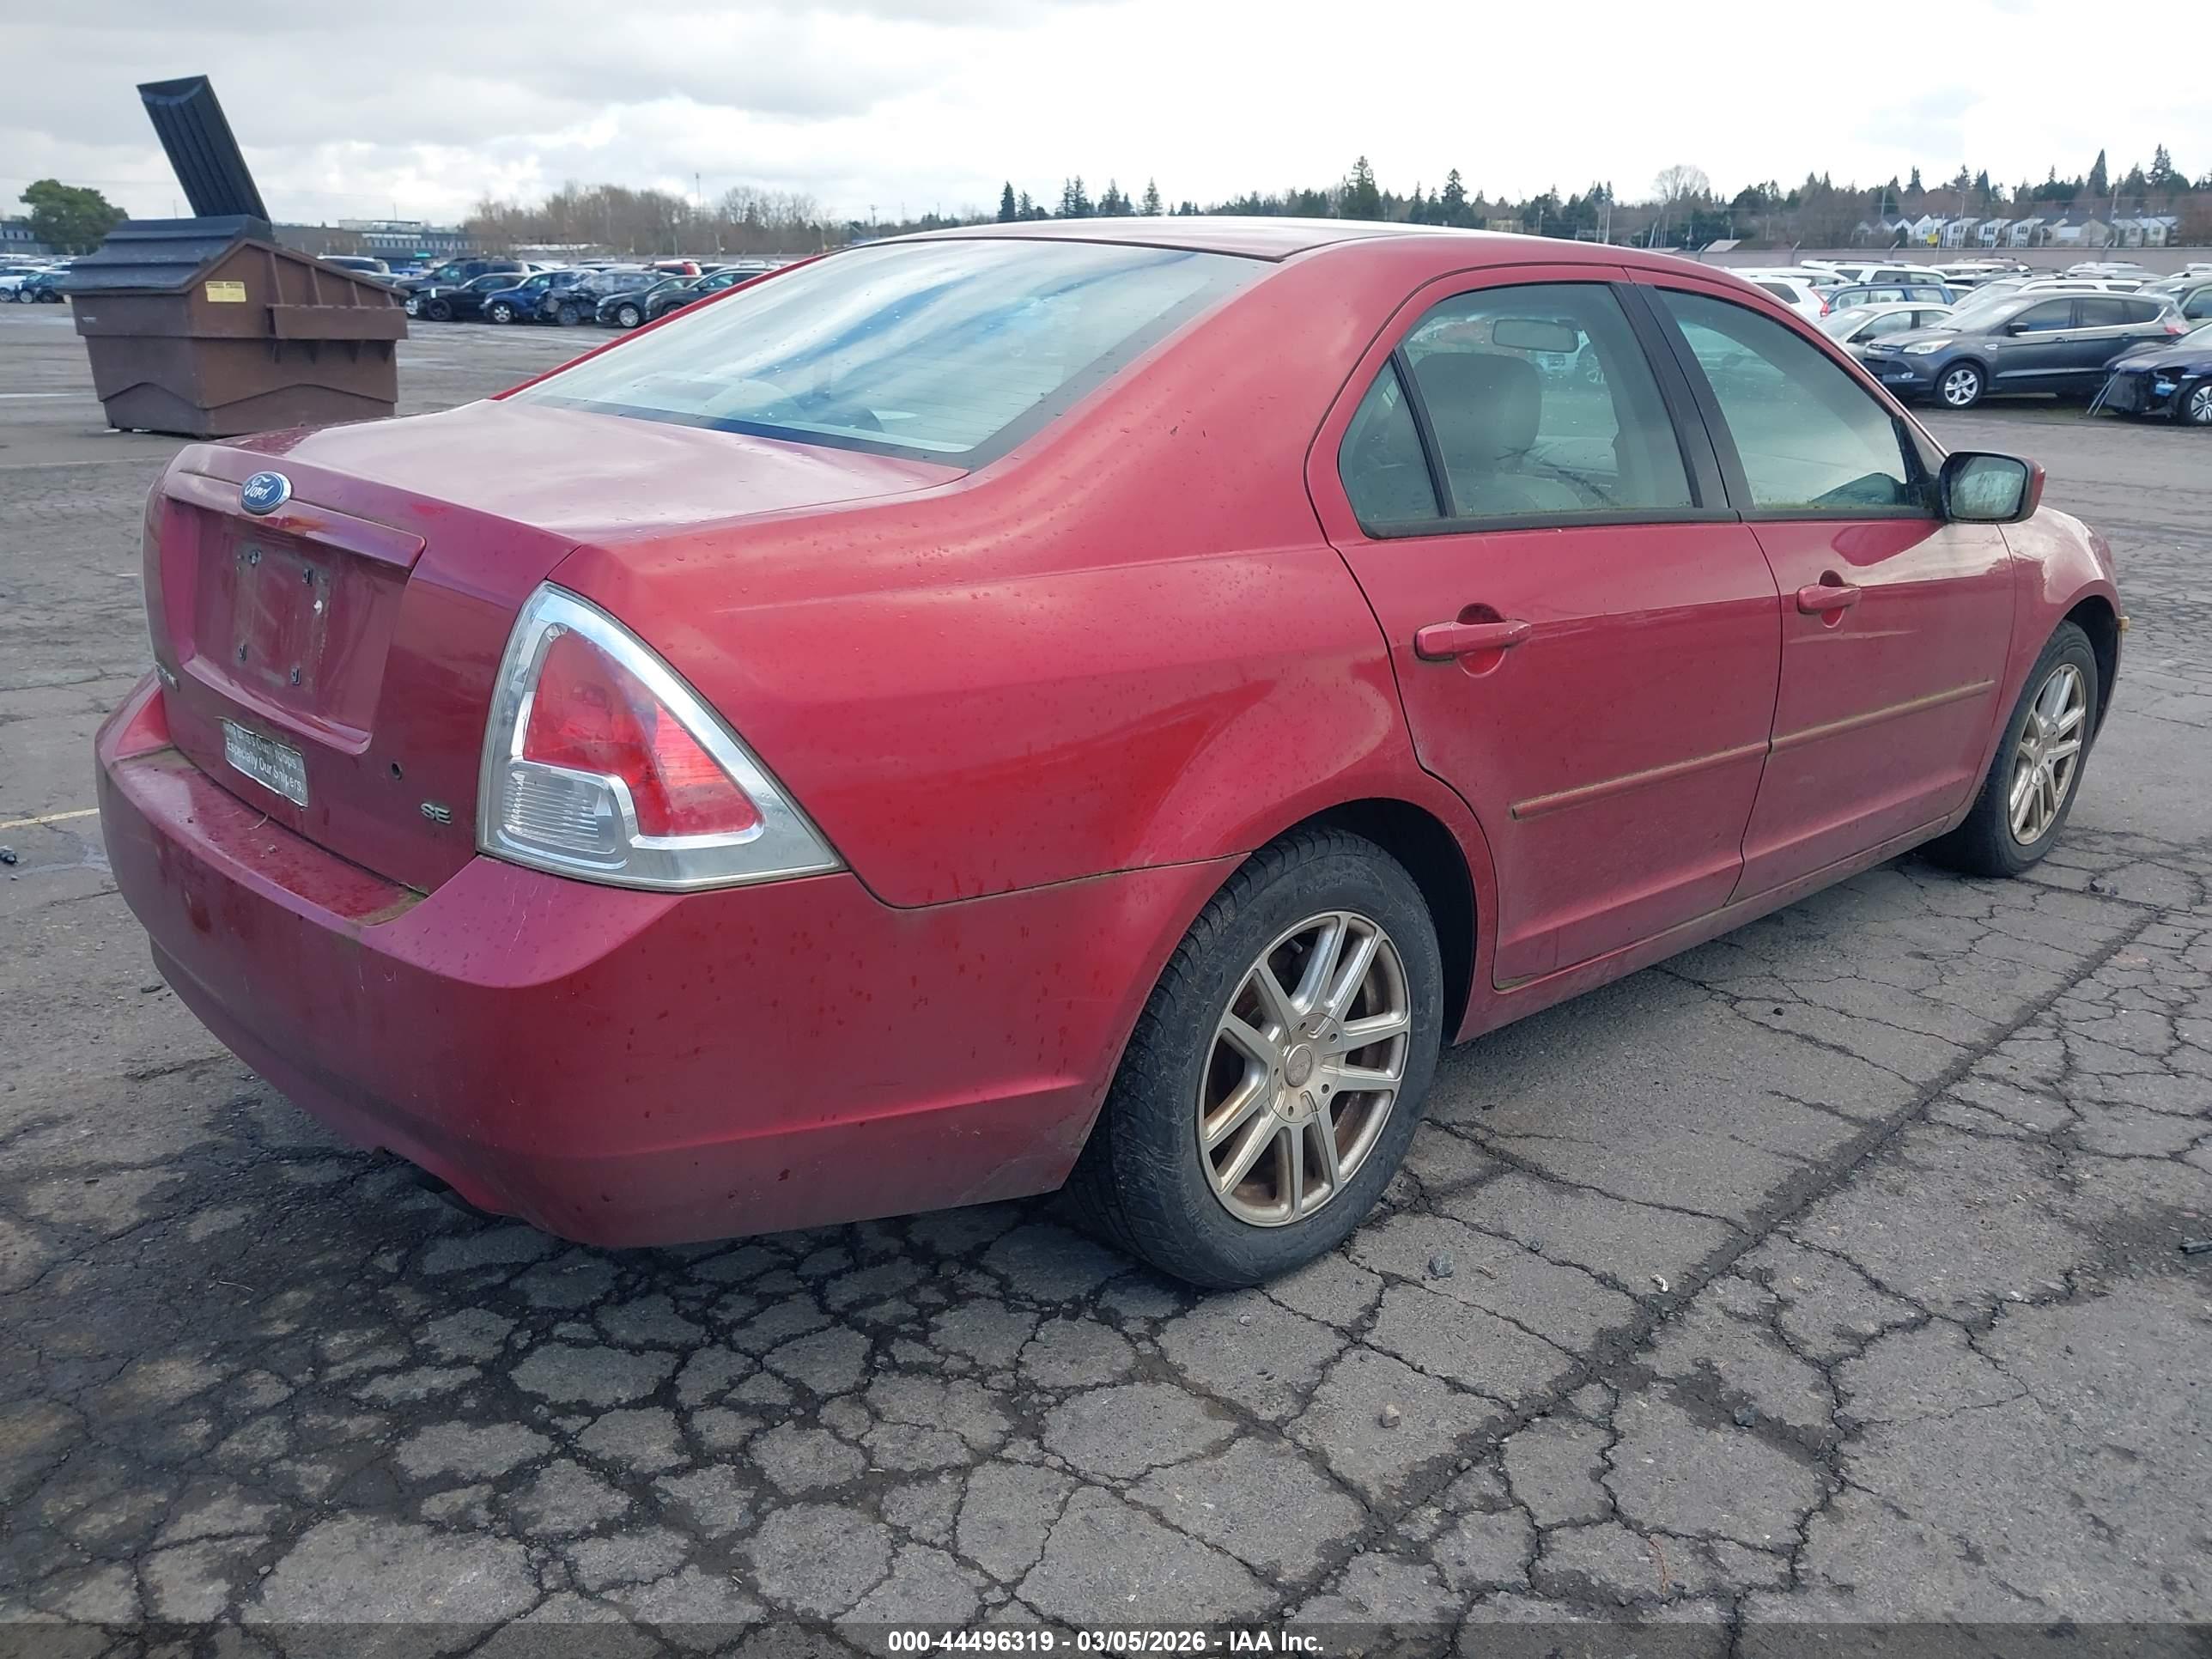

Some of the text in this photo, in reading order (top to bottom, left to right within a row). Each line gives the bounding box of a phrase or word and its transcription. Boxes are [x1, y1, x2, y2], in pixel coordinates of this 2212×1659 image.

[244, 475, 274, 501] Ford
[259, 757, 272, 775] Our
[421, 803, 452, 824] SE
